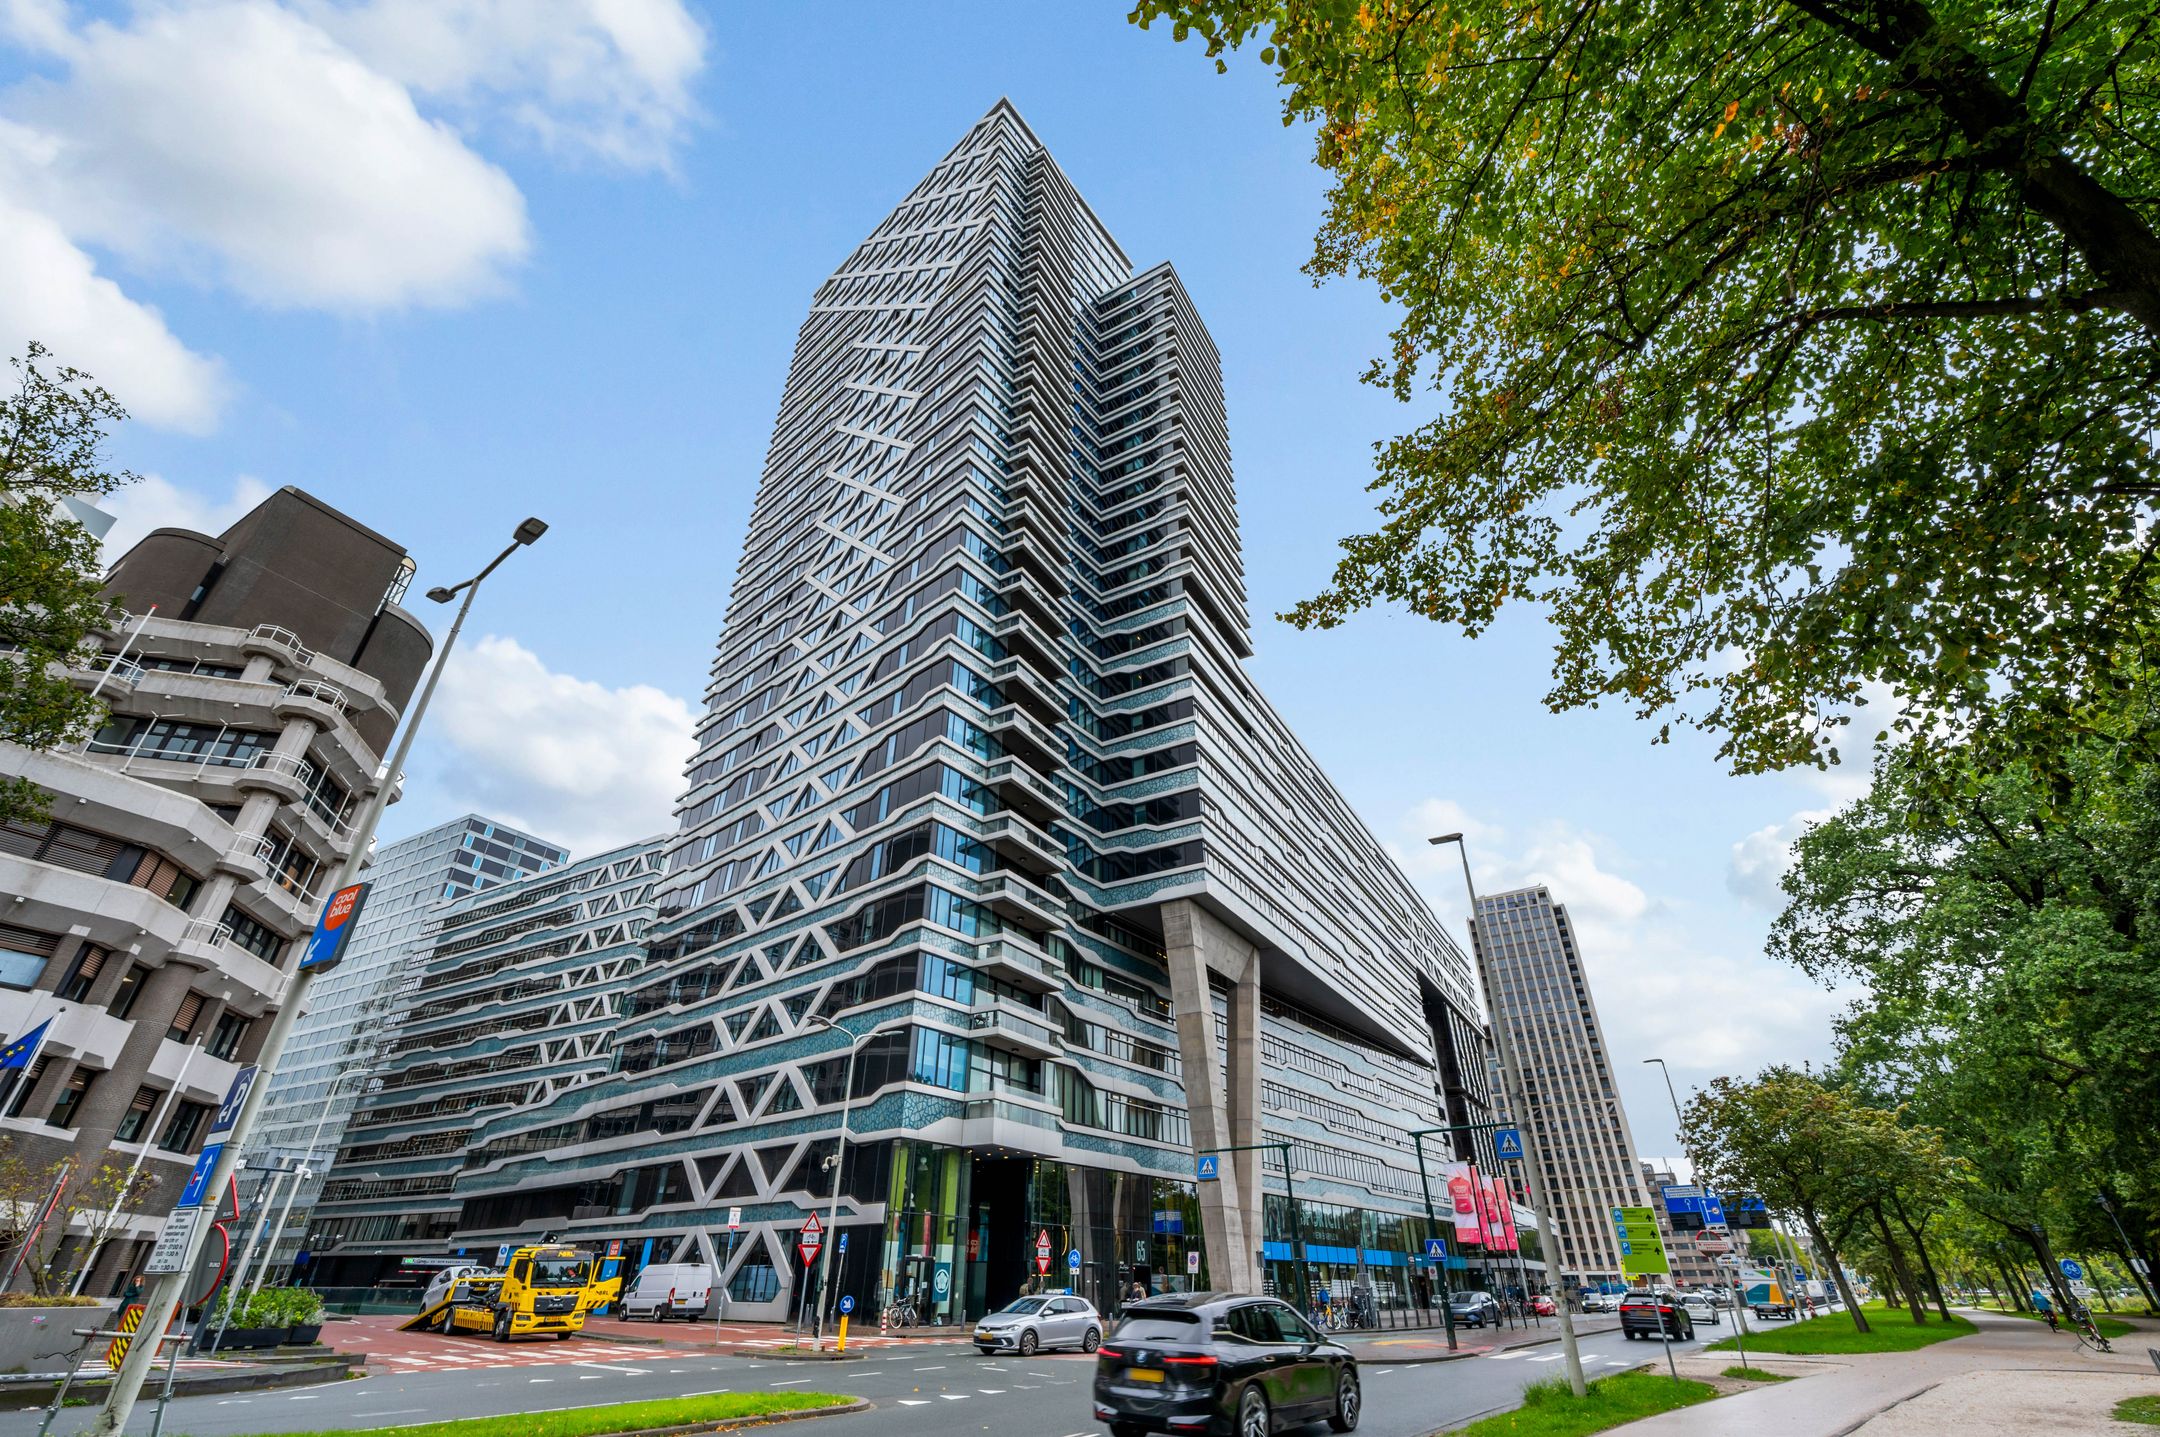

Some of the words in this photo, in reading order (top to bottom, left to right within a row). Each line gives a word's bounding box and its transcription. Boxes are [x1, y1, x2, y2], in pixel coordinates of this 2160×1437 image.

[335, 888, 359, 905] cool
[329, 903, 352, 918] blue
[1136, 1240, 1146, 1262] 65
